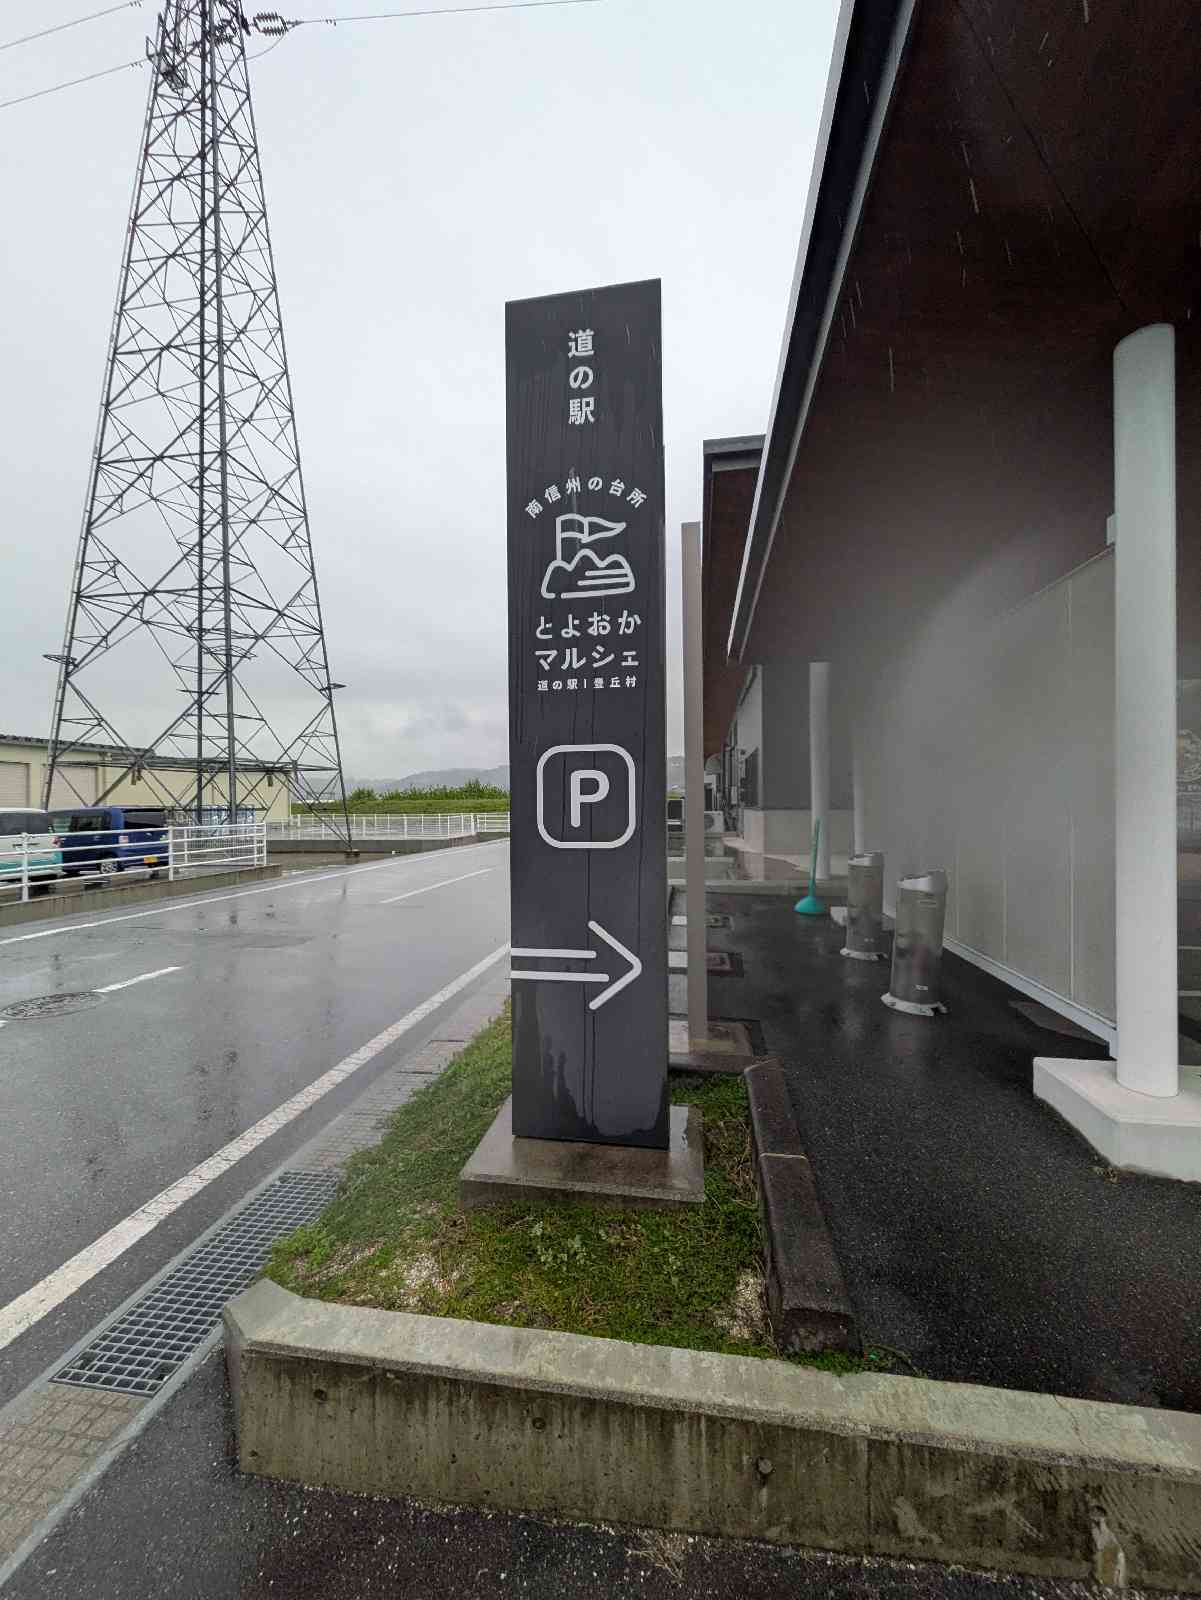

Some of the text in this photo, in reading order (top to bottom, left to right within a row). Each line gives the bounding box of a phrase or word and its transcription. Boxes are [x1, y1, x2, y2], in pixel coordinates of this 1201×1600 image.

[568, 329, 595, 425] 道の駅
[525, 476, 647, 518] 南信州の台所
[535, 610, 641, 639] とよおか
[535, 645, 639, 671] マルシェ
[570, 769, 610, 828] P
